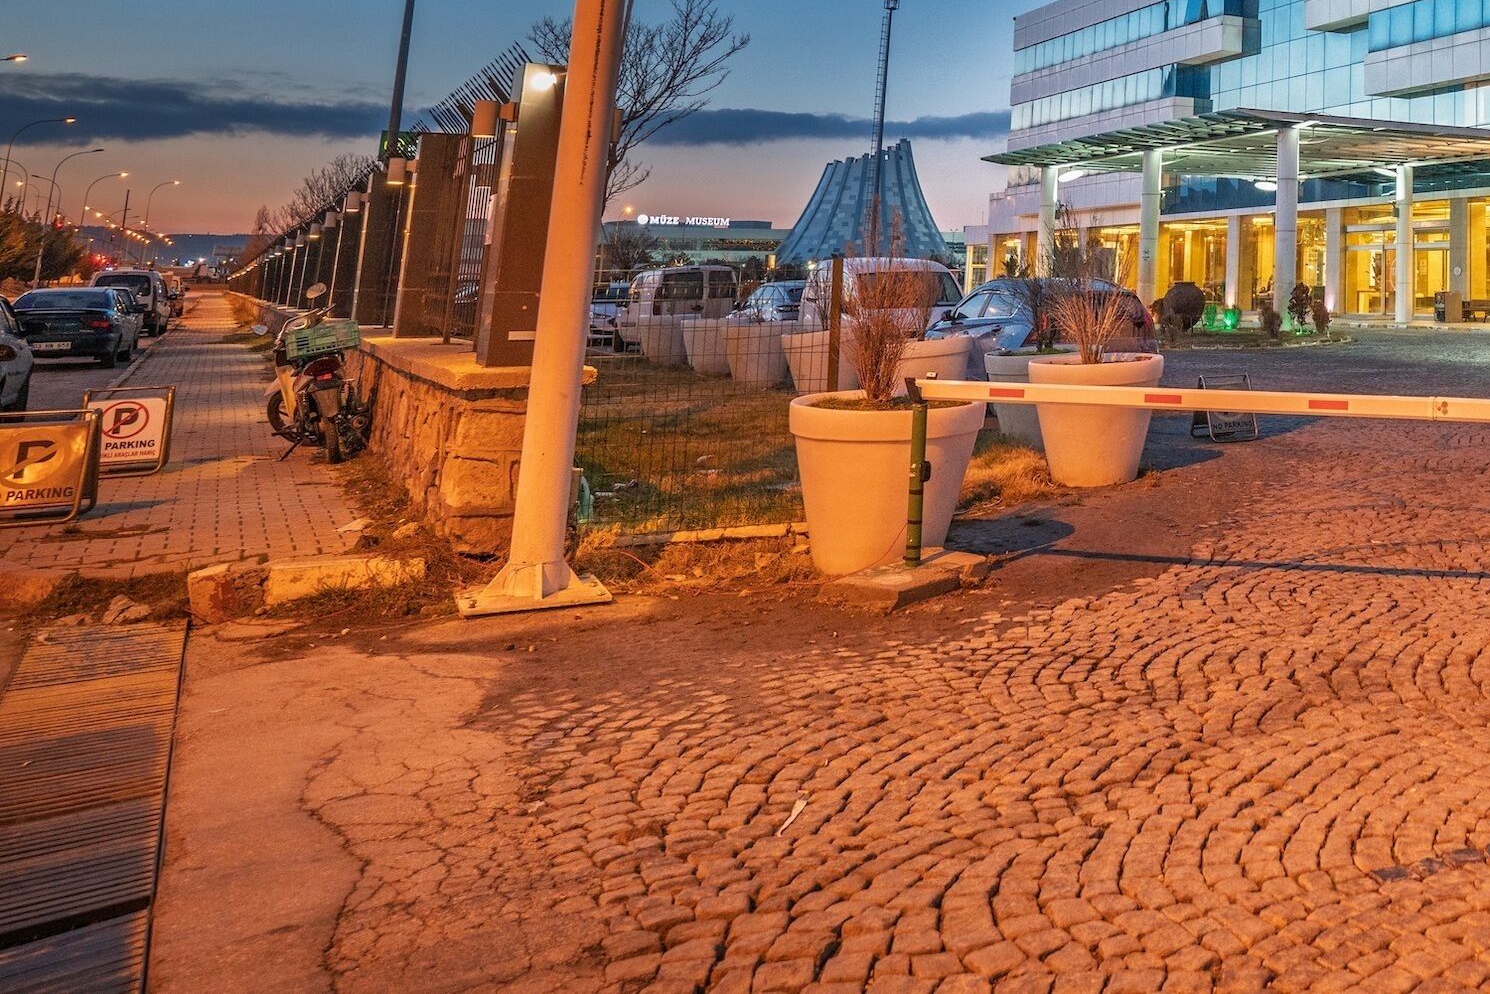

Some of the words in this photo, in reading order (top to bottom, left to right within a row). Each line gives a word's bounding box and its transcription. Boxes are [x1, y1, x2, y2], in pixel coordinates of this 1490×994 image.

[649, 214, 680, 225] MÜZE
[684, 216, 730, 226] MUSEUM
[1224, 421, 1252, 429] PARKING
[105, 439, 155, 450] PARKING
[6, 486, 74, 502] PARKING
